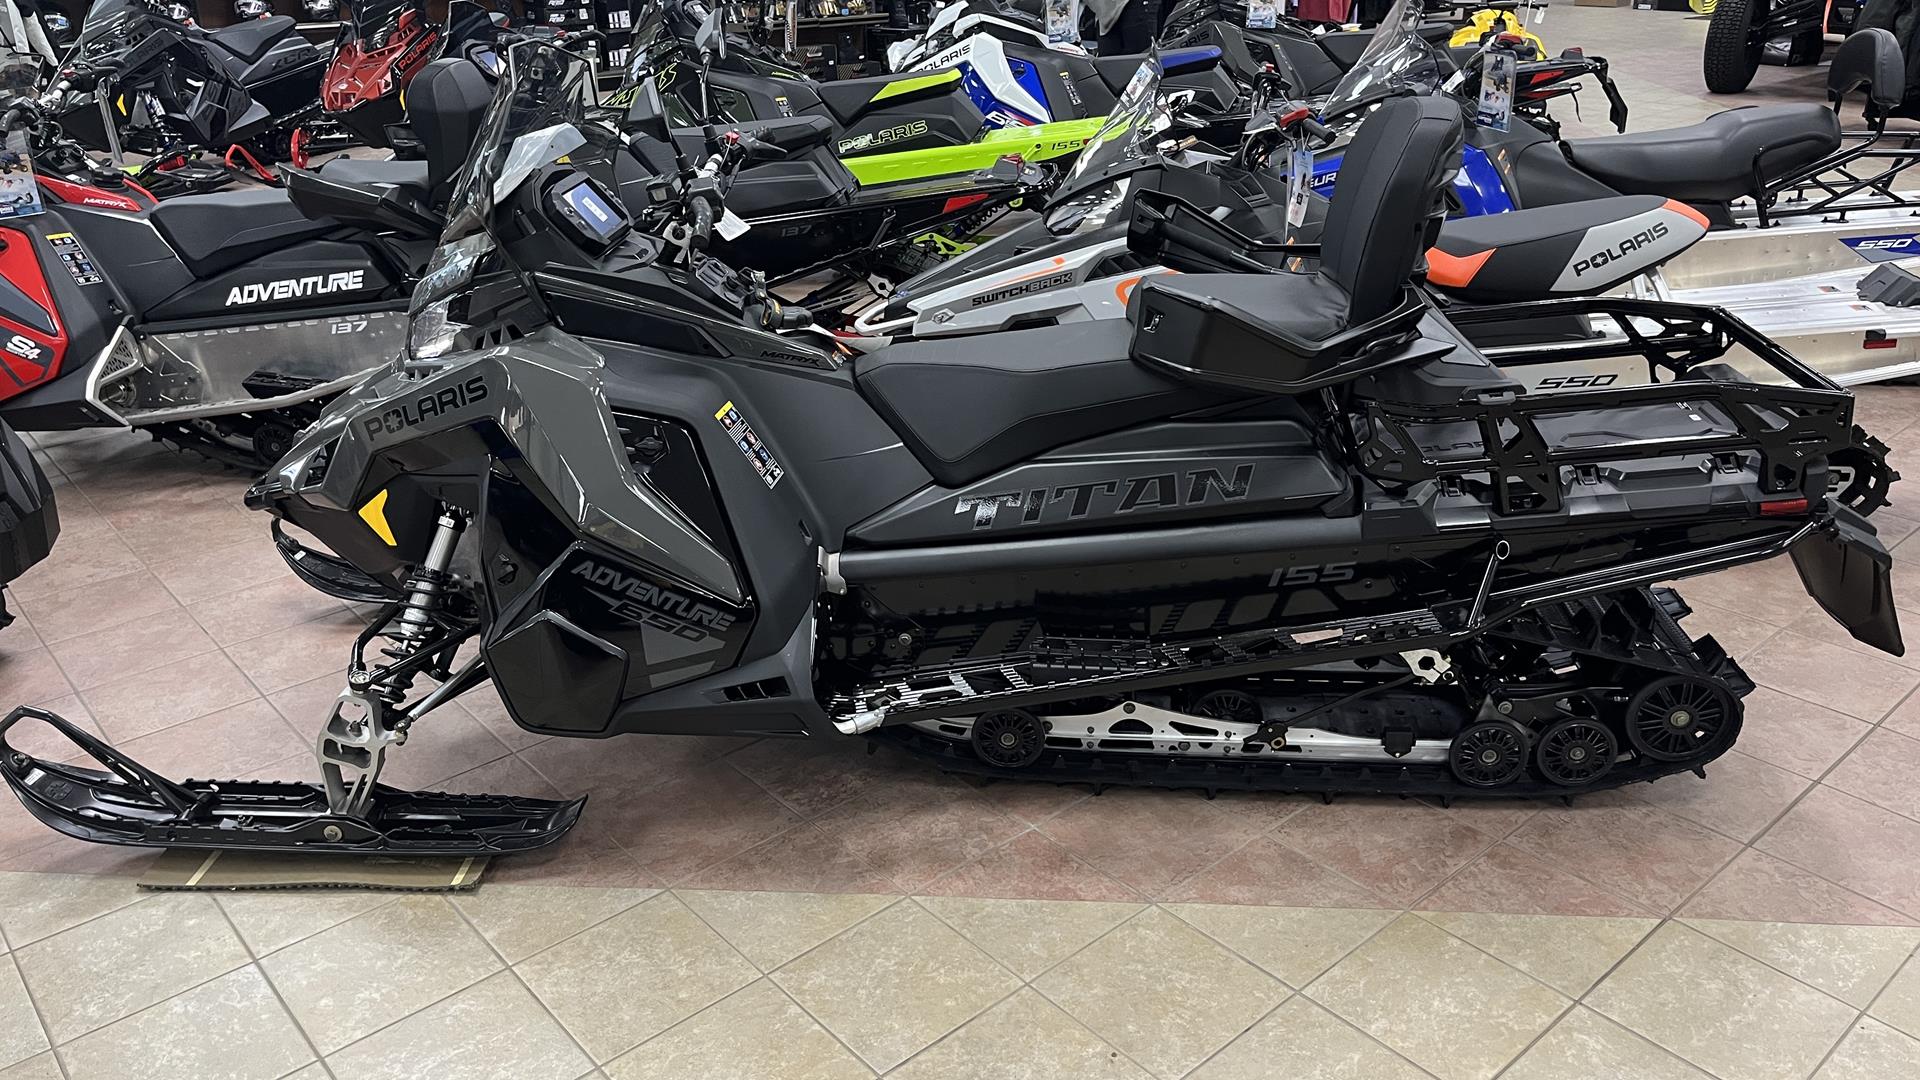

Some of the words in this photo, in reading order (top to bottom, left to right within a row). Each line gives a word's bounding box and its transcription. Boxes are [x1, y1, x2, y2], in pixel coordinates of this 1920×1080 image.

[398, 31, 437, 69] POLARIS
[838, 120, 928, 153] POLARIS
[1052, 140, 1081, 151] 155
[83, 197, 127, 208] MATRYX
[782, 224, 812, 237] 137
[1573, 222, 1669, 277] POLARIS
[224, 269, 365, 307] ADVENTURE
[972, 272, 1073, 307] SWITCHBACK
[331, 320, 369, 335] 137
[6, 335, 42, 360] S4
[760, 350, 819, 367] MATRYX
[1535, 374, 1619, 390] 550
[363, 375, 489, 441] POLARIS
[954, 463, 1257, 531] TITAN
[1268, 561, 1357, 587] 155
[570, 559, 737, 632] ADVENTURE
[609, 600, 709, 642] 650
